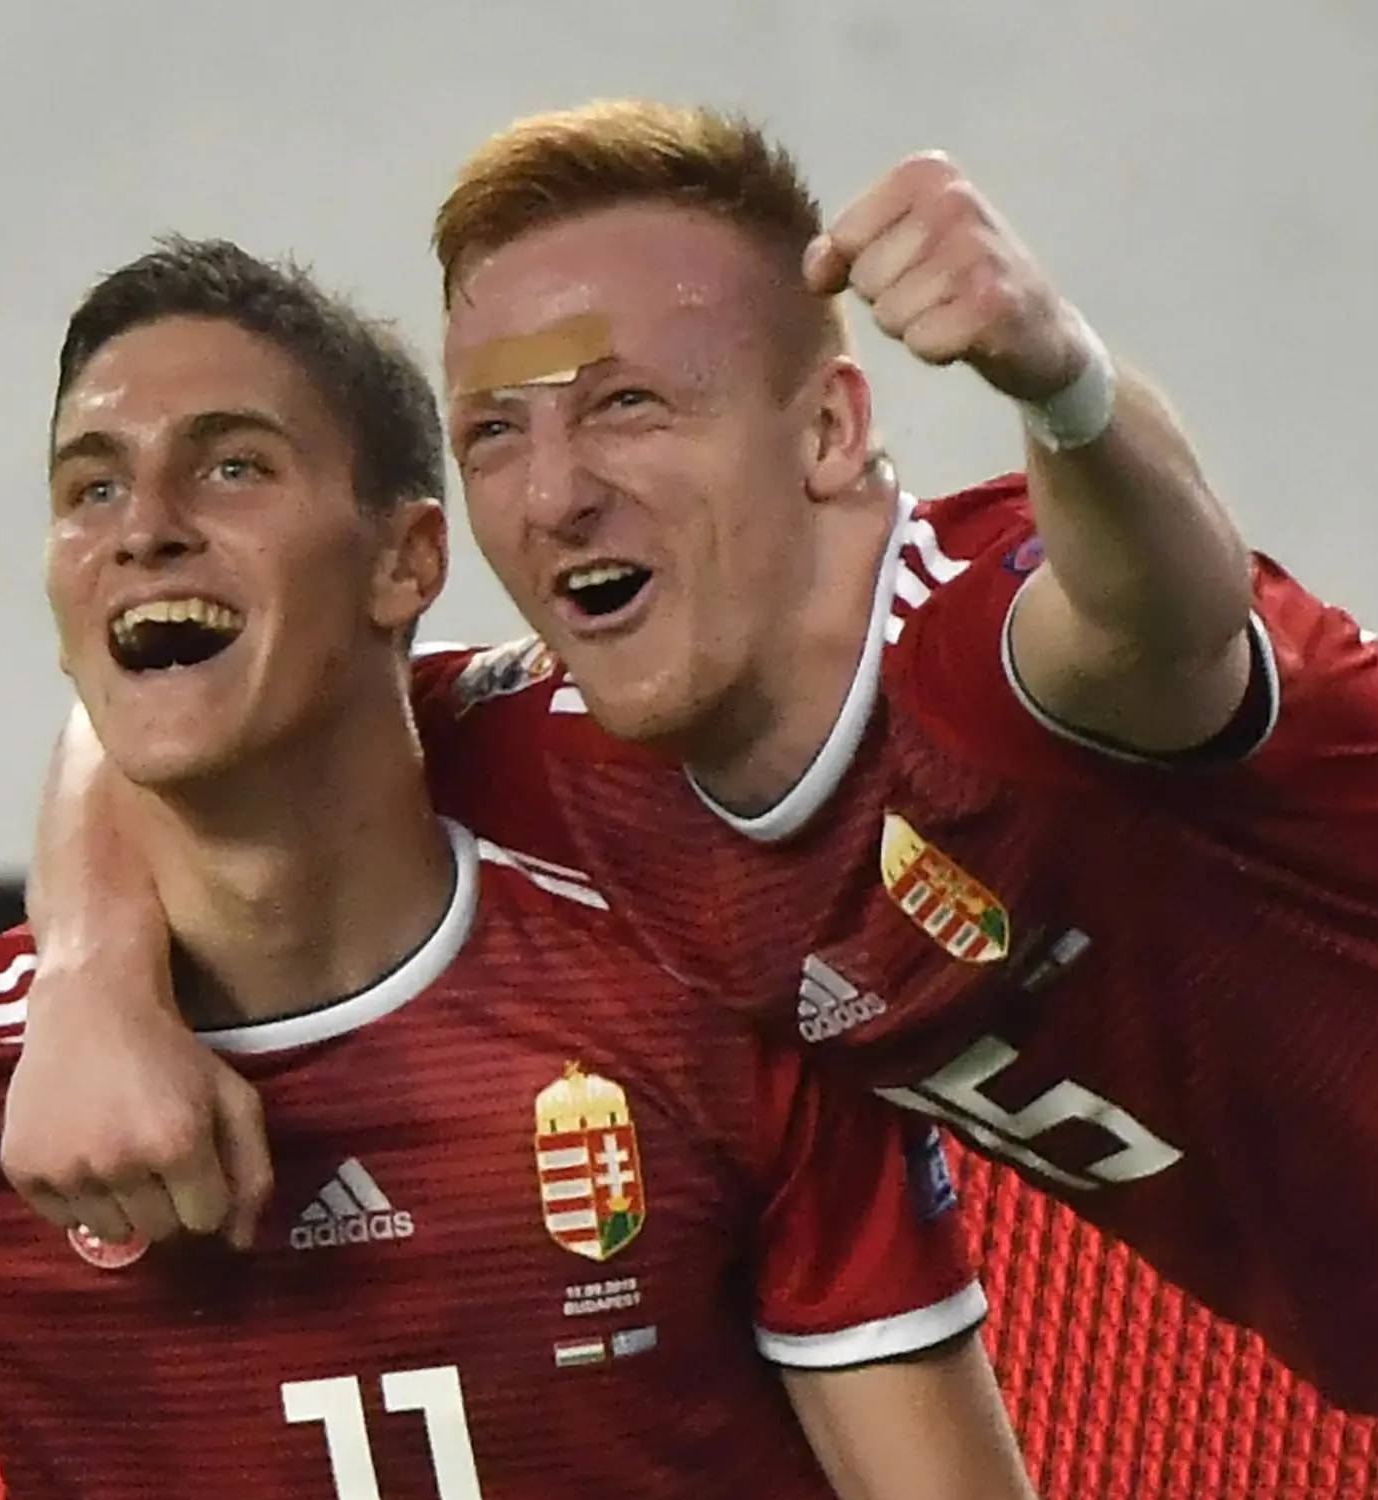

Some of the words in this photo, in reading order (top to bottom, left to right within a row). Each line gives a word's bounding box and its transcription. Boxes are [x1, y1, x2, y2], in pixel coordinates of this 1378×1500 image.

[799, 992, 886, 1042] adidas
[290, 1211, 415, 1249] adidas
[563, 1291, 641, 1316] BUDAPEST
